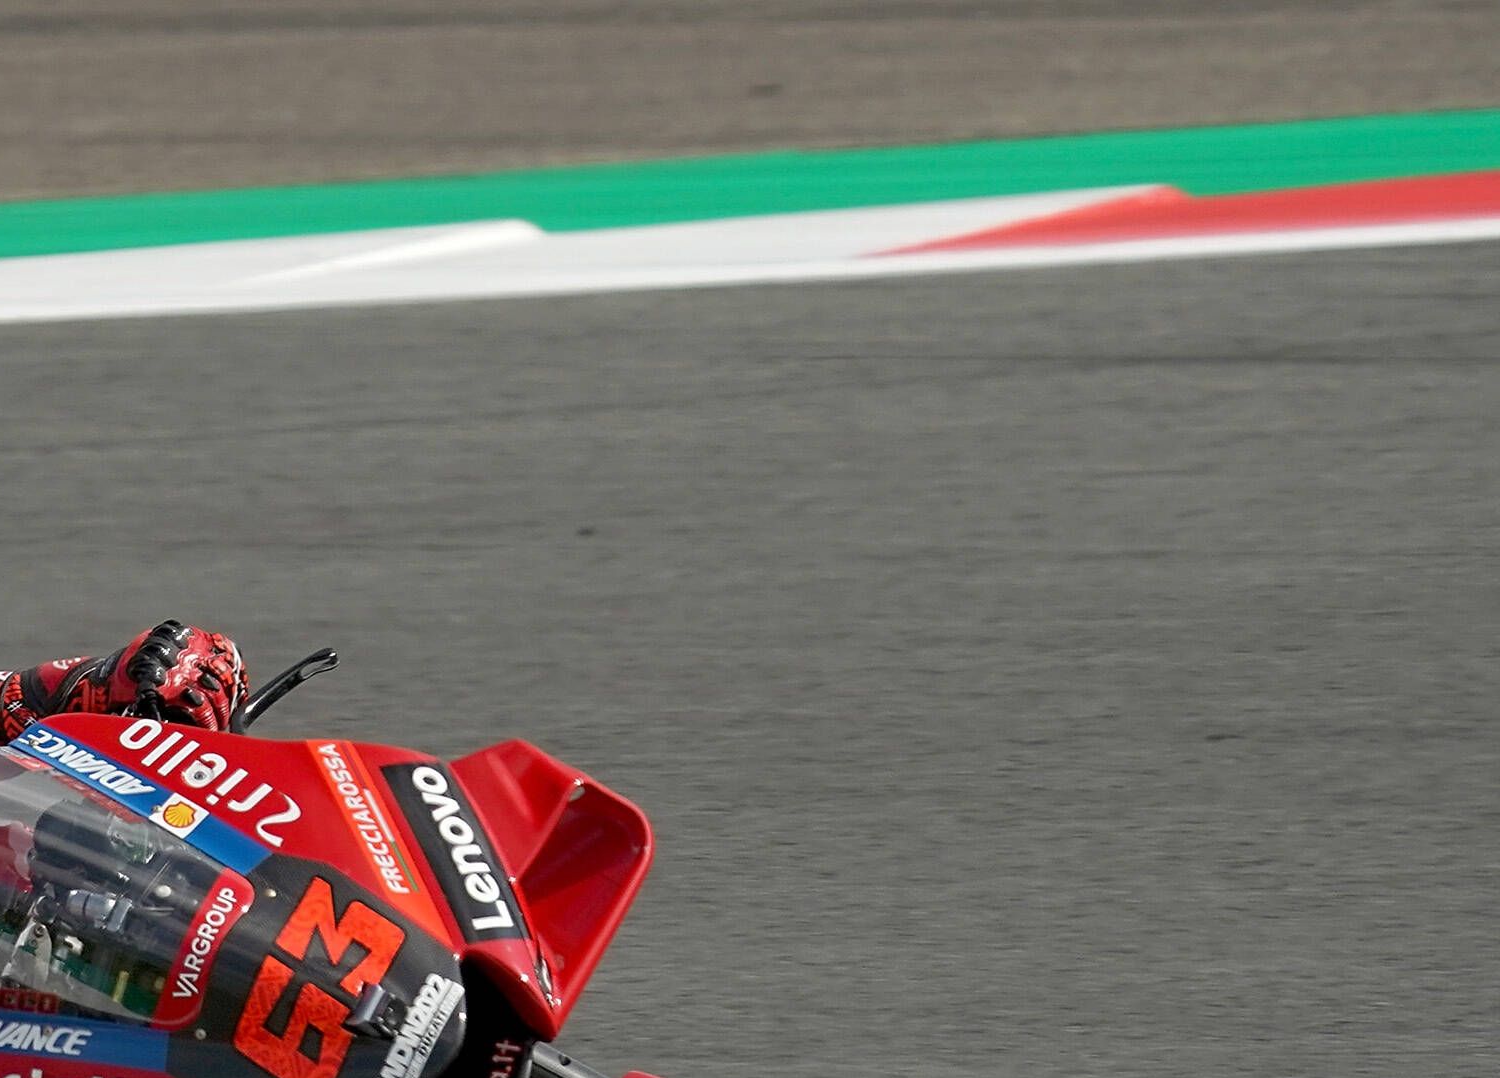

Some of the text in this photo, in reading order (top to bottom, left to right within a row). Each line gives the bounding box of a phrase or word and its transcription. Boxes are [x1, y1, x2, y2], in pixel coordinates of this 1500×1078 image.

[16, 727, 157, 797] ADVANCE
[118, 718, 272, 812] riello
[319, 743, 407, 896] FRECCIAROSSA
[412, 765, 515, 932] Lenovo
[172, 887, 238, 1000] VARGROUP
